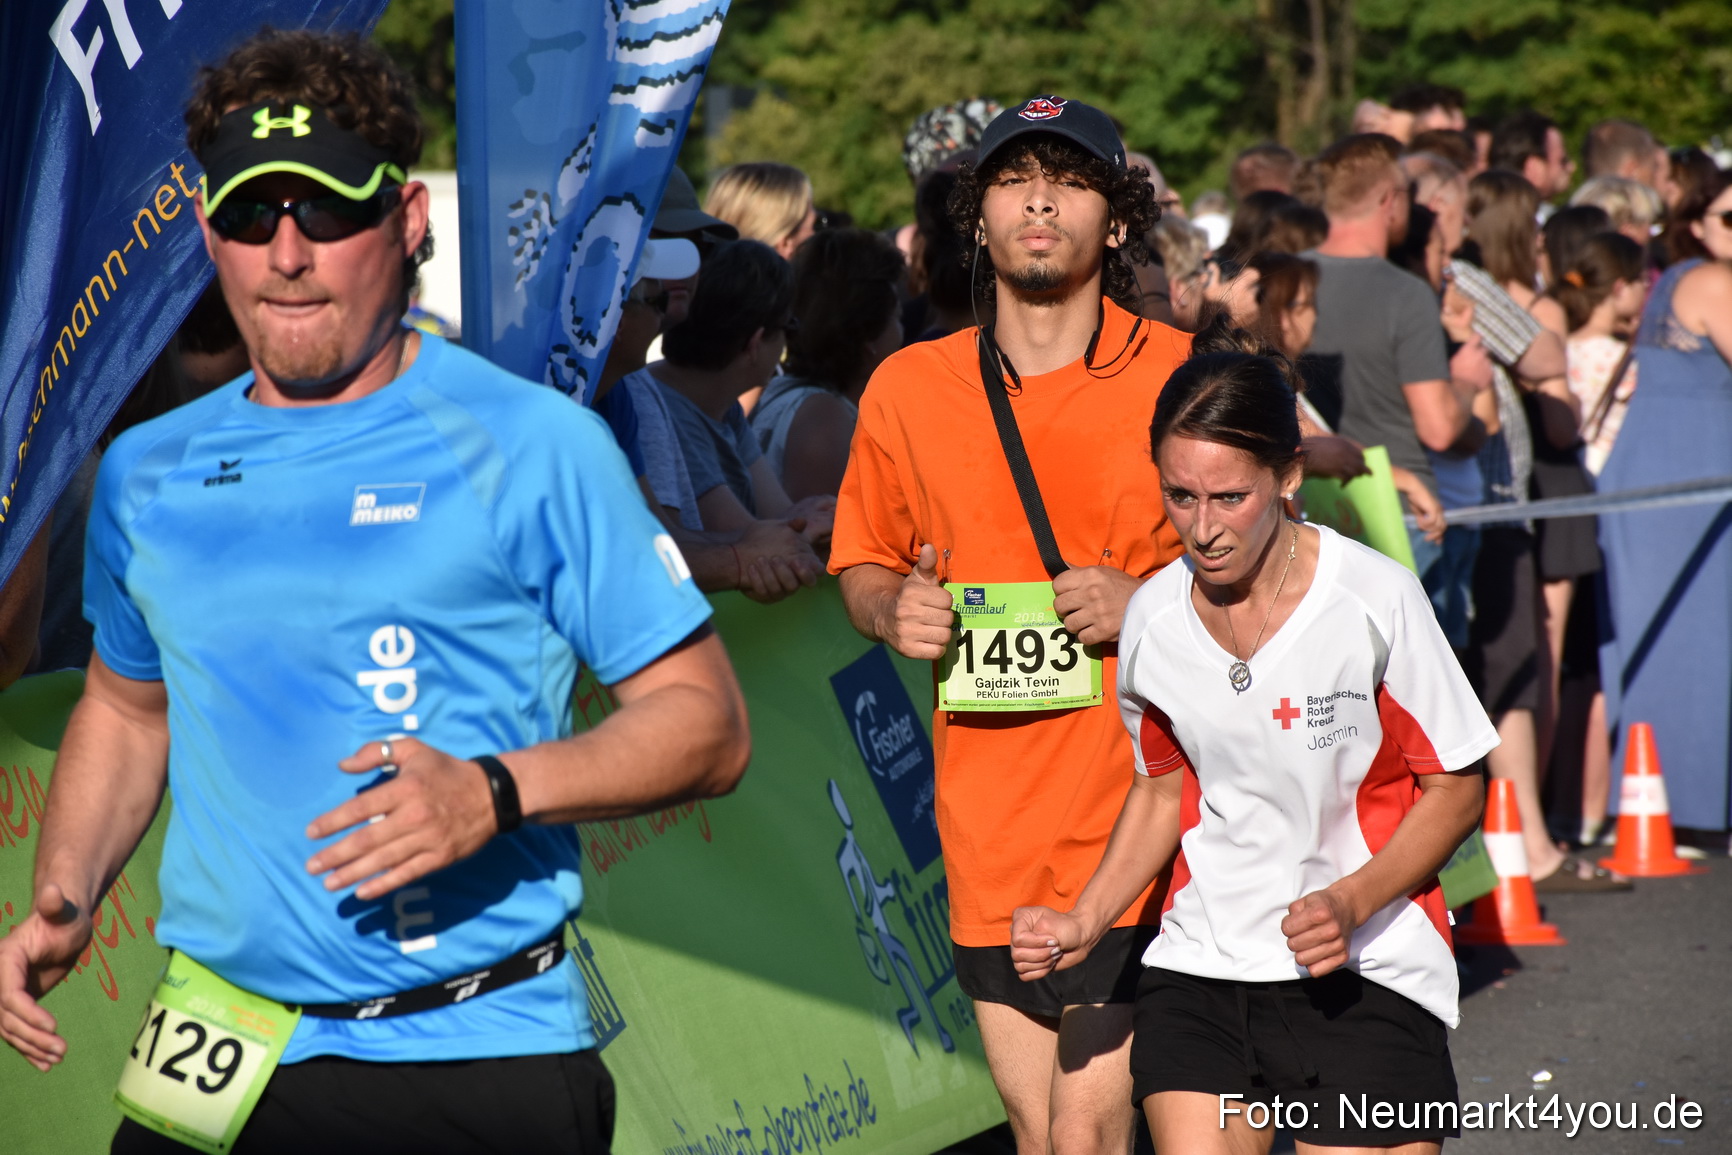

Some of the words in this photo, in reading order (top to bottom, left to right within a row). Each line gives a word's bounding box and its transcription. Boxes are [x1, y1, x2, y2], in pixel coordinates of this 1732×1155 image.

[203, 473, 242, 487] erima
[956, 602, 1007, 614] firmenlauf
[1014, 612, 1045, 623] 2018
[956, 628, 1079, 674] 1493
[975, 677, 1020, 691] Gajdzik
[1024, 676, 1060, 688] Tevin
[976, 690, 1000, 699] PEKU
[1002, 690, 1029, 699] Folien
[1031, 689, 1059, 698] GmbH
[1307, 690, 1367, 706] Bayerisches
[1307, 704, 1335, 717] Rotes
[1307, 714, 1335, 728] Kreuz
[868, 713, 916, 764] Fischer
[1307, 725, 1358, 750] Jasmin
